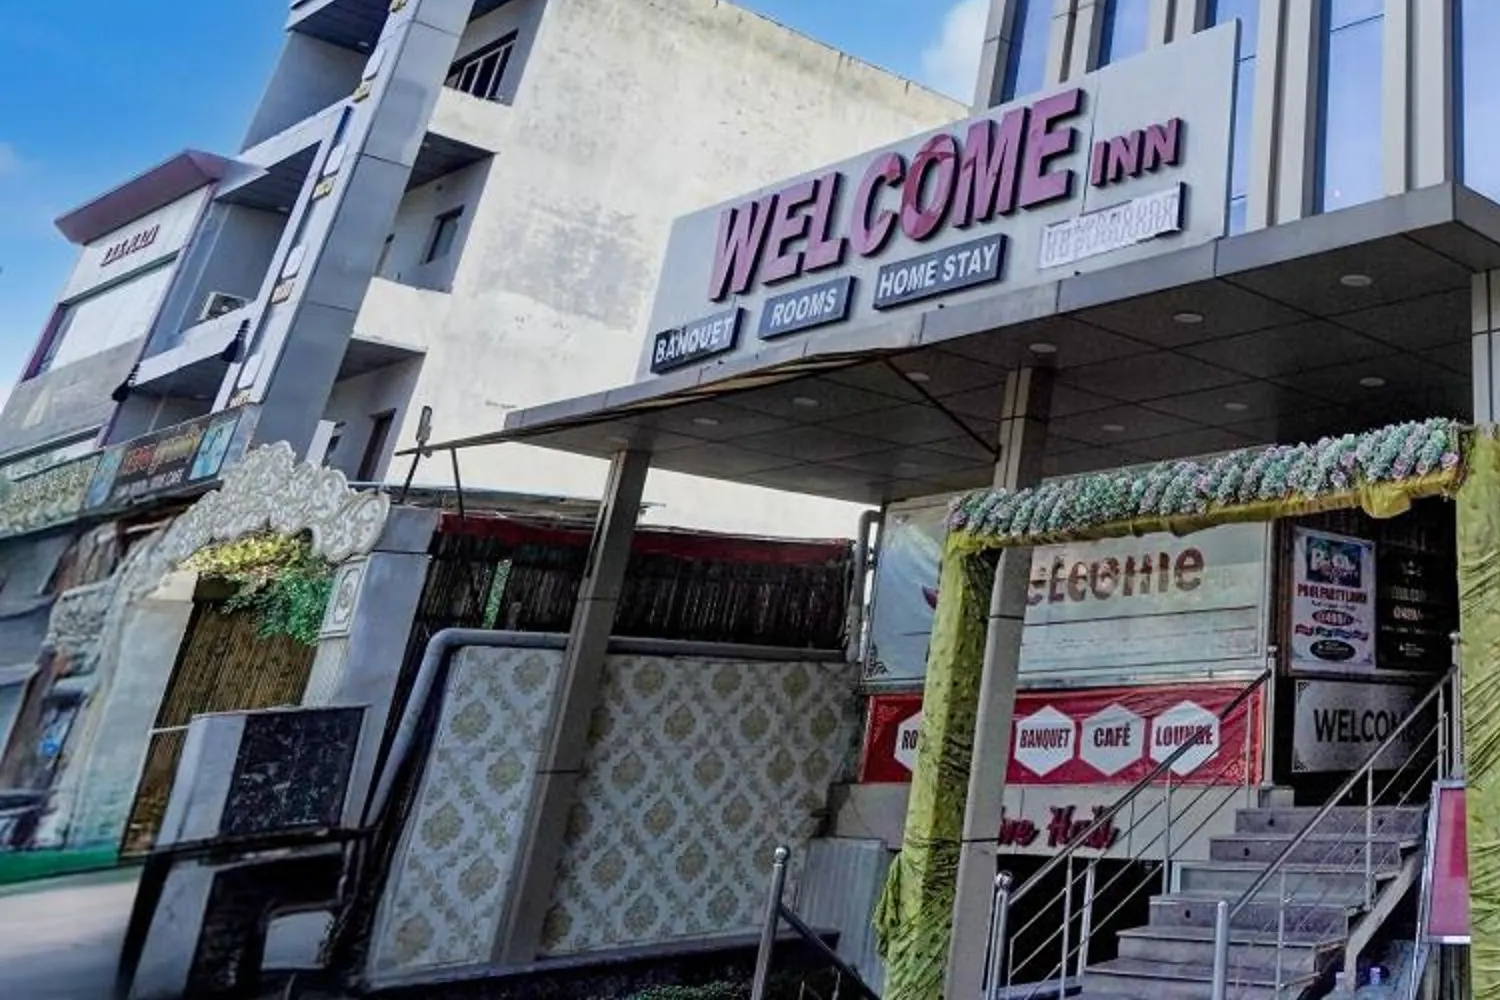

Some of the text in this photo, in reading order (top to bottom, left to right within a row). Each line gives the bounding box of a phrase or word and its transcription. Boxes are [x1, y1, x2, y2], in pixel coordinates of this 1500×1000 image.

[710, 87, 1084, 301] WELCOME
[1090, 117, 1182, 187] INN
[877, 242, 999, 299] HOME STAY
[769, 287, 838, 328] ROOMS
[655, 315, 733, 363] BANQUET
[1020, 727, 1071, 751] BANQUET
[1093, 721, 1131, 747] CAFÉ
